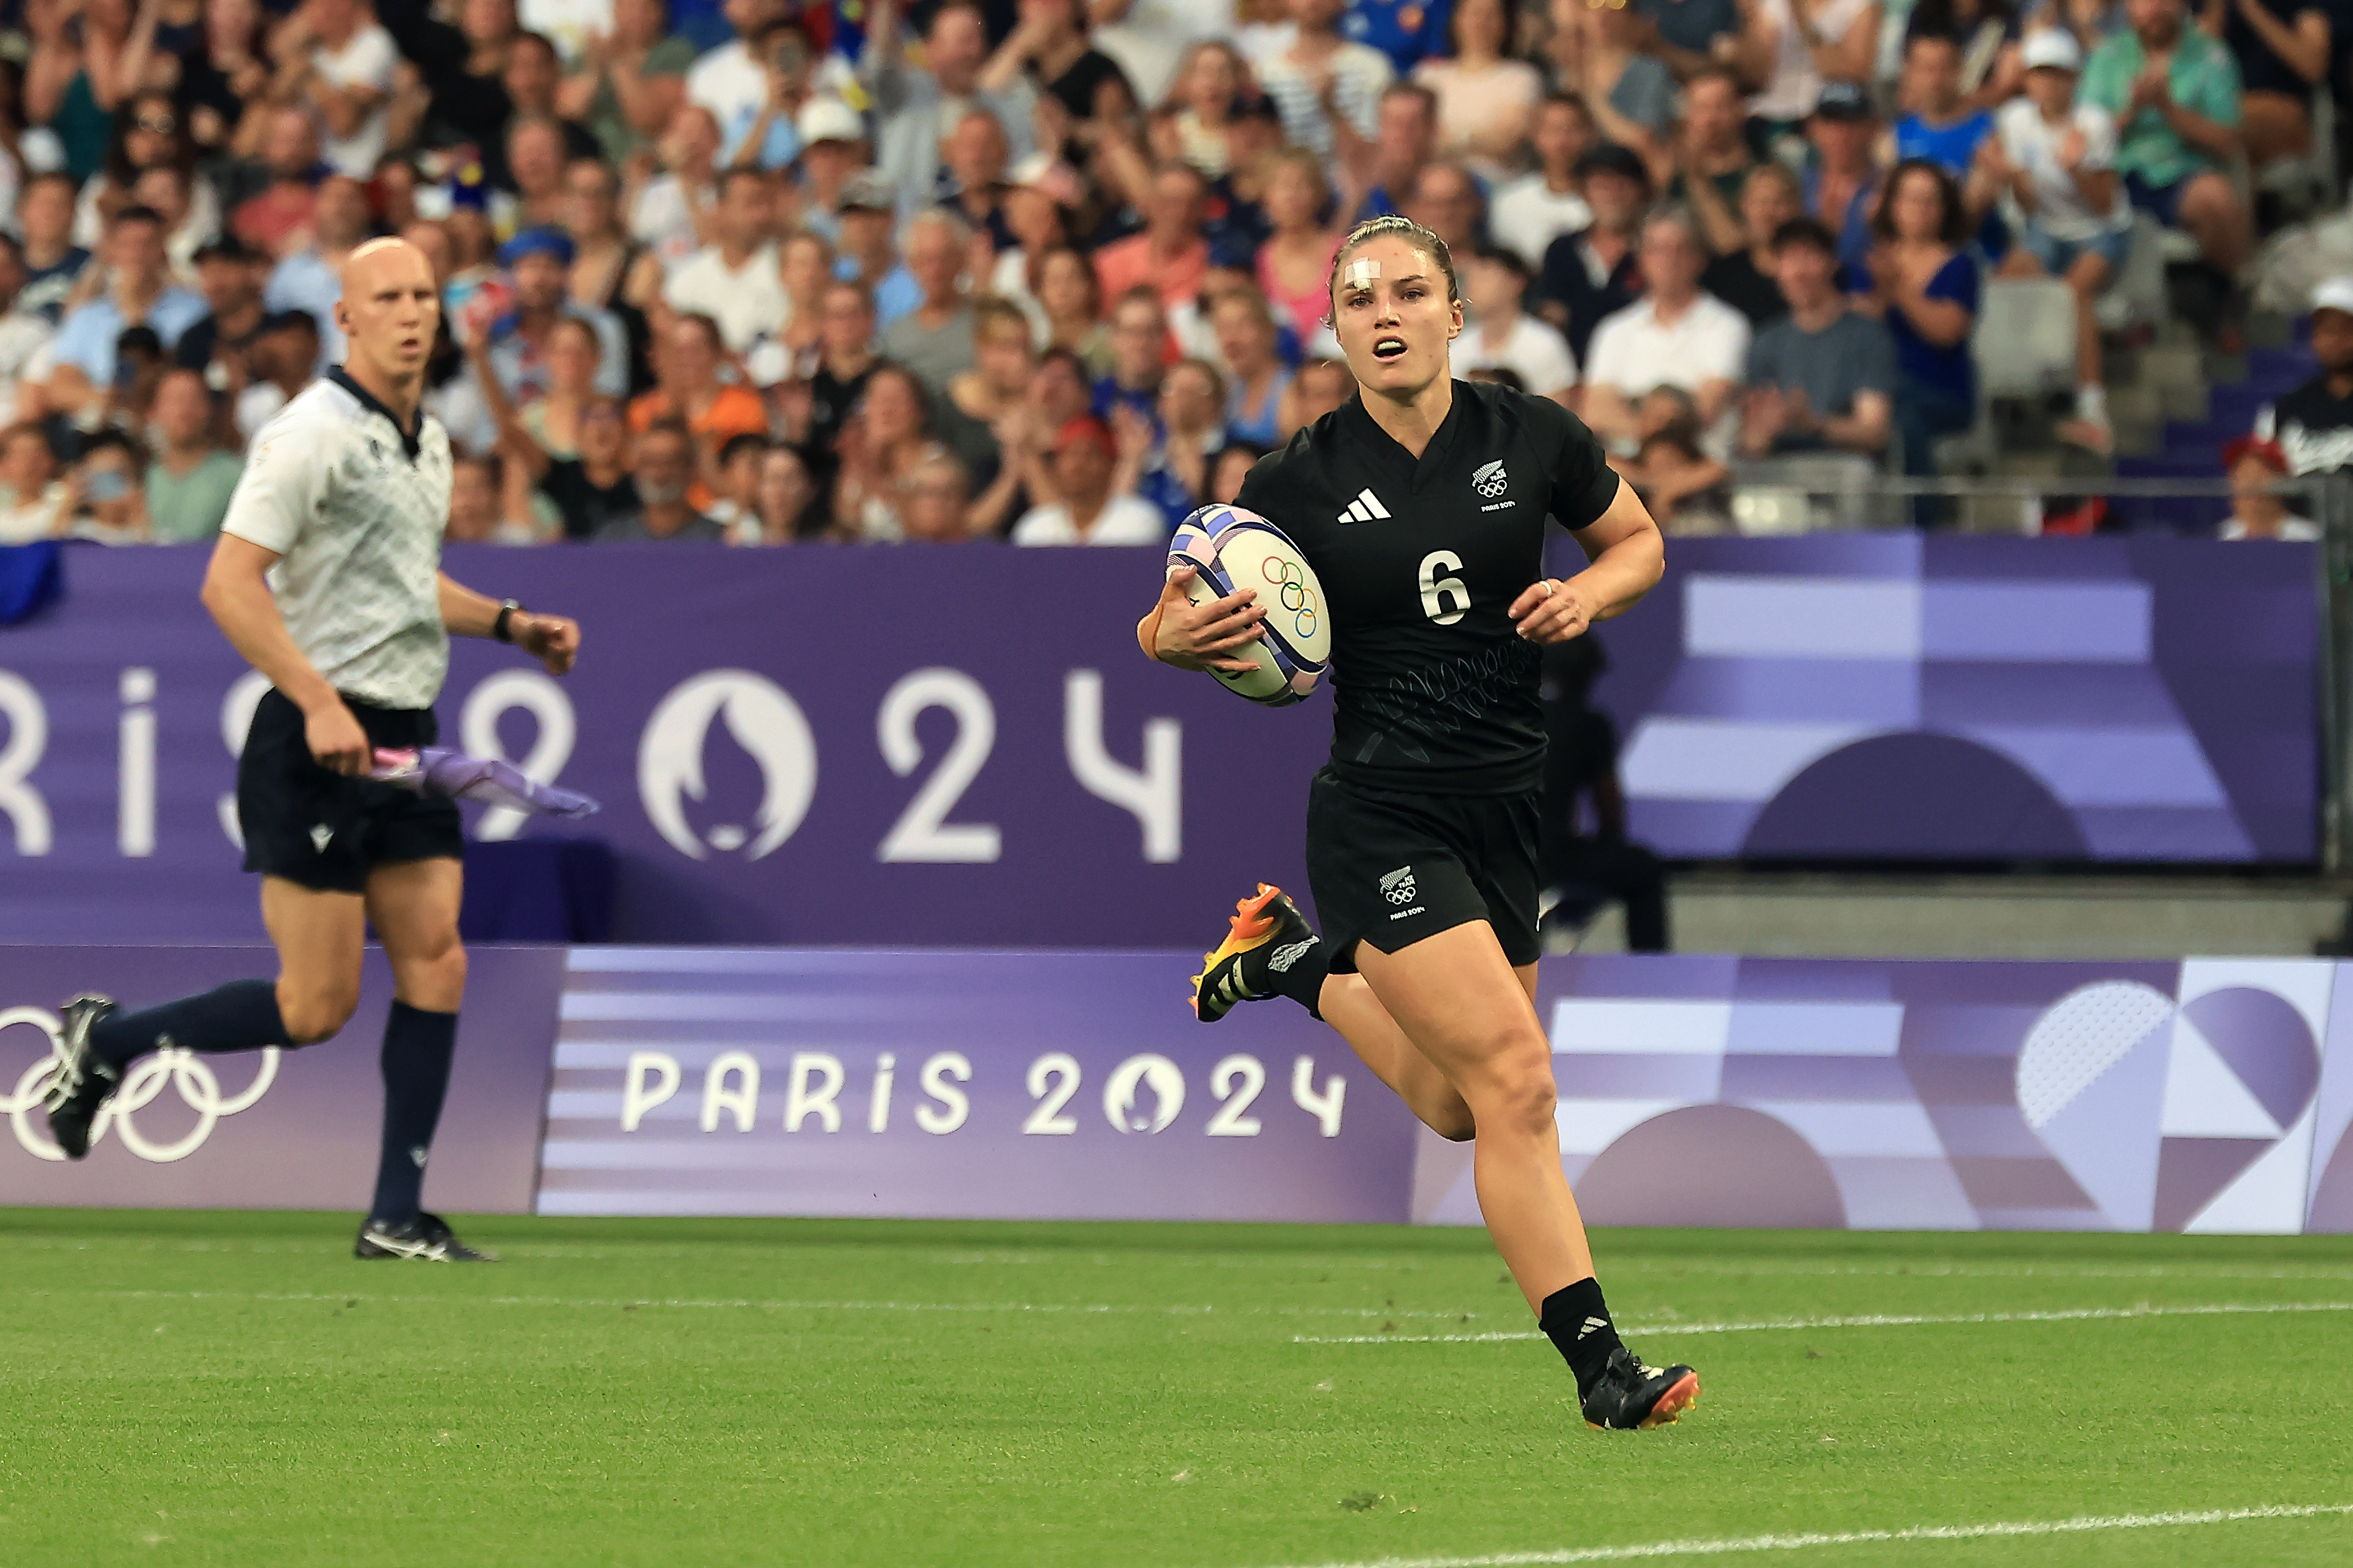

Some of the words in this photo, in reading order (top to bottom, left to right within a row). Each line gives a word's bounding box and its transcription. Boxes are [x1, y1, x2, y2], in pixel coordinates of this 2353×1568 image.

[1500, 501, 1516, 509] 2024
[1419, 550, 1471, 625] 6
[1407, 906, 1425, 916] 2024
[1023, 1051, 1347, 1138] 2024
